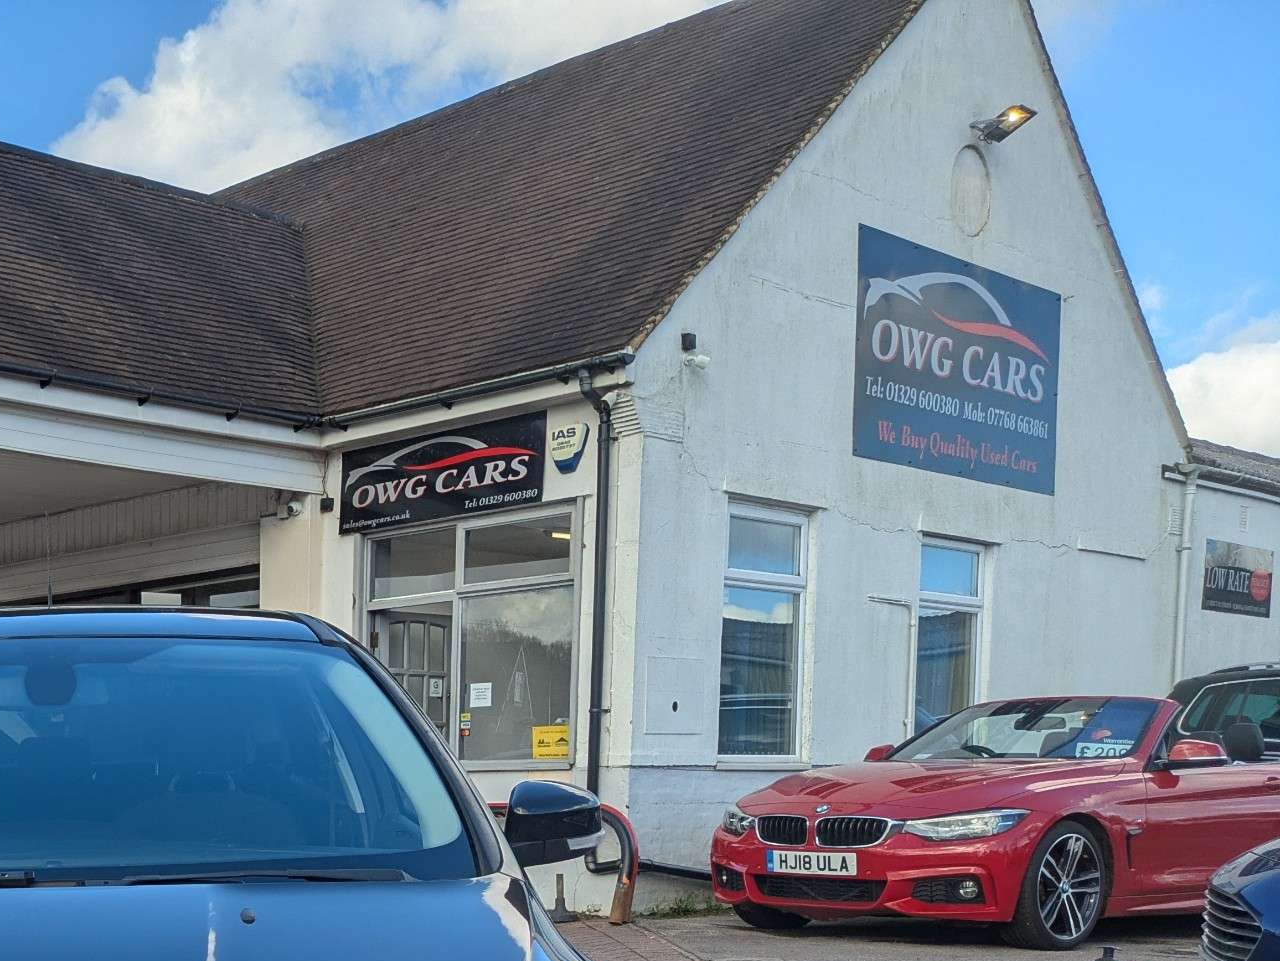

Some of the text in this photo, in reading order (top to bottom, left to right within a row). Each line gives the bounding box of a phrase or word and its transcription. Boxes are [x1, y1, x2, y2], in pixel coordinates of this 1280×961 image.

[871, 319, 1046, 403] OWG CARS
[865, 375, 1049, 439] Tel: 01329 600380 Mob: 07768 663861
[551, 427, 577, 442] IAS
[878, 420, 1037, 473] We Buy Quality Used Cars
[352, 456, 530, 509] OWG CARS
[479, 495, 503, 506] 01329
[504, 489, 538, 502] 600380
[1206, 567, 1227, 590] LOW
[817, 855, 849, 872] ULA
